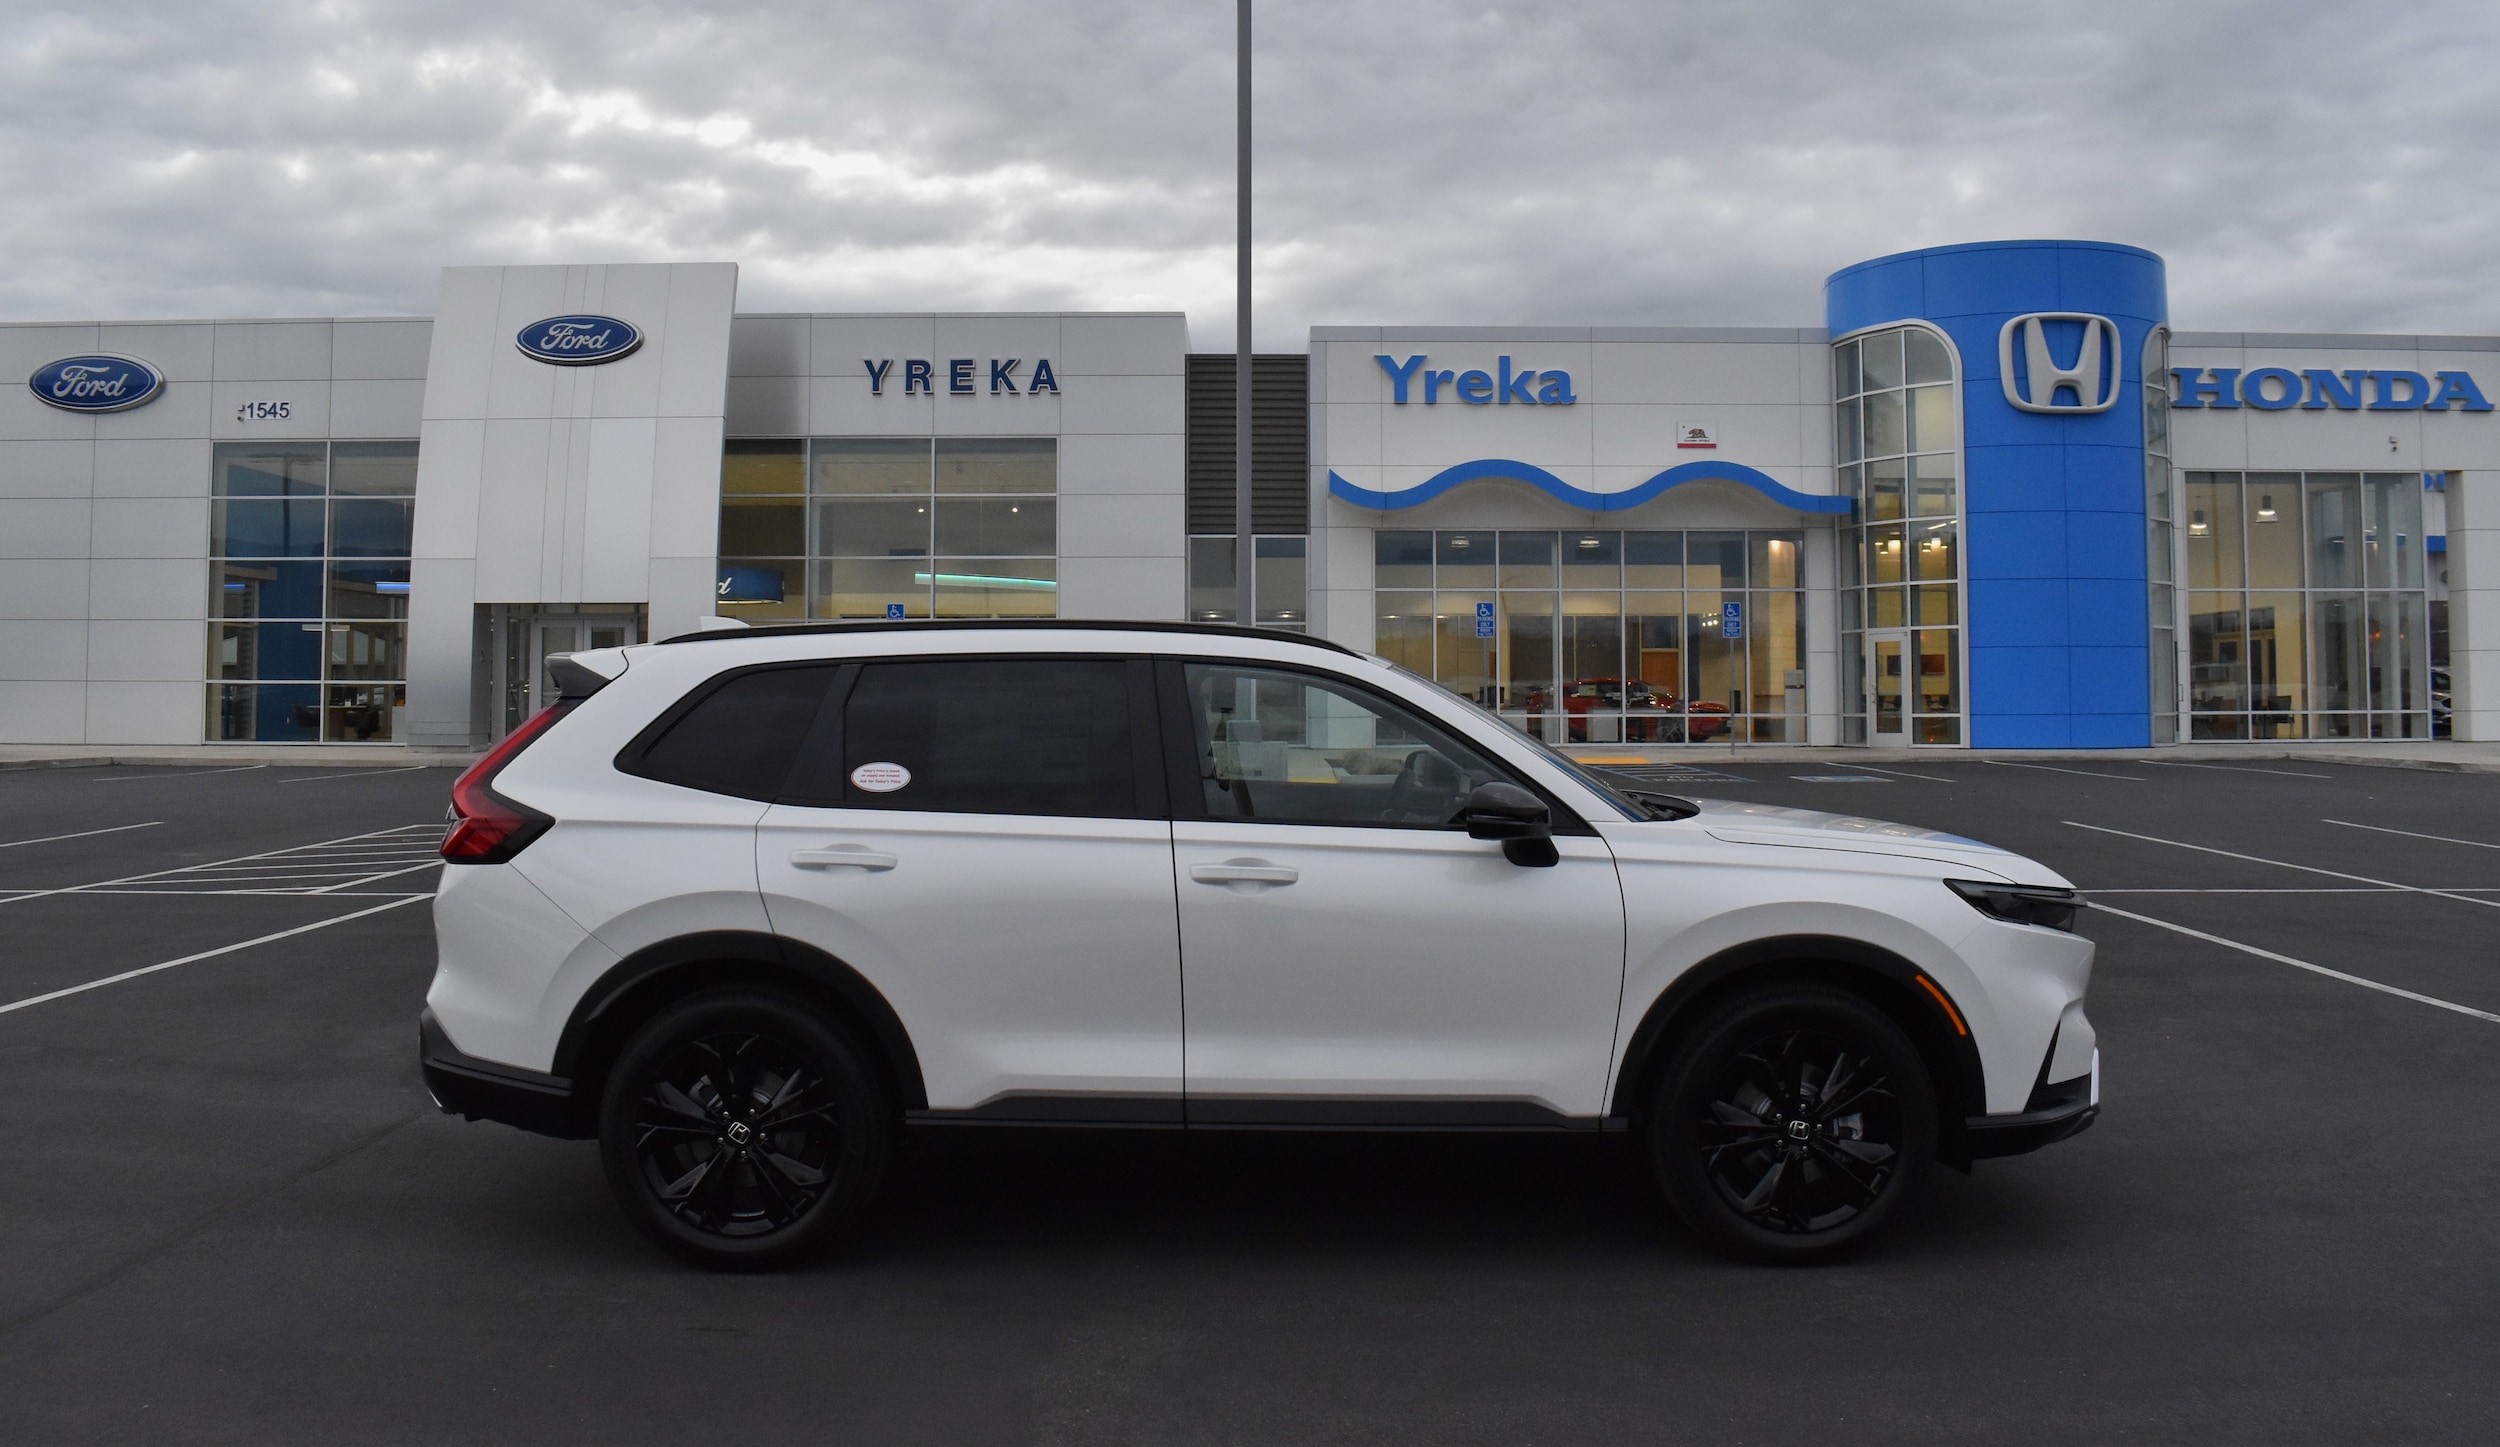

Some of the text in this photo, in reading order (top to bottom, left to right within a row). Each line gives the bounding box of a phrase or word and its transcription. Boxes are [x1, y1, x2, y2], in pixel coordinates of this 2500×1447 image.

[540, 322, 612, 350] Ford
[53, 365, 129, 398] Ford
[863, 358, 1060, 395] YREKA
[1373, 354, 1577, 405] Yreka
[2170, 367, 2496, 411] HONDA
[246, 402, 290, 419] 1545
